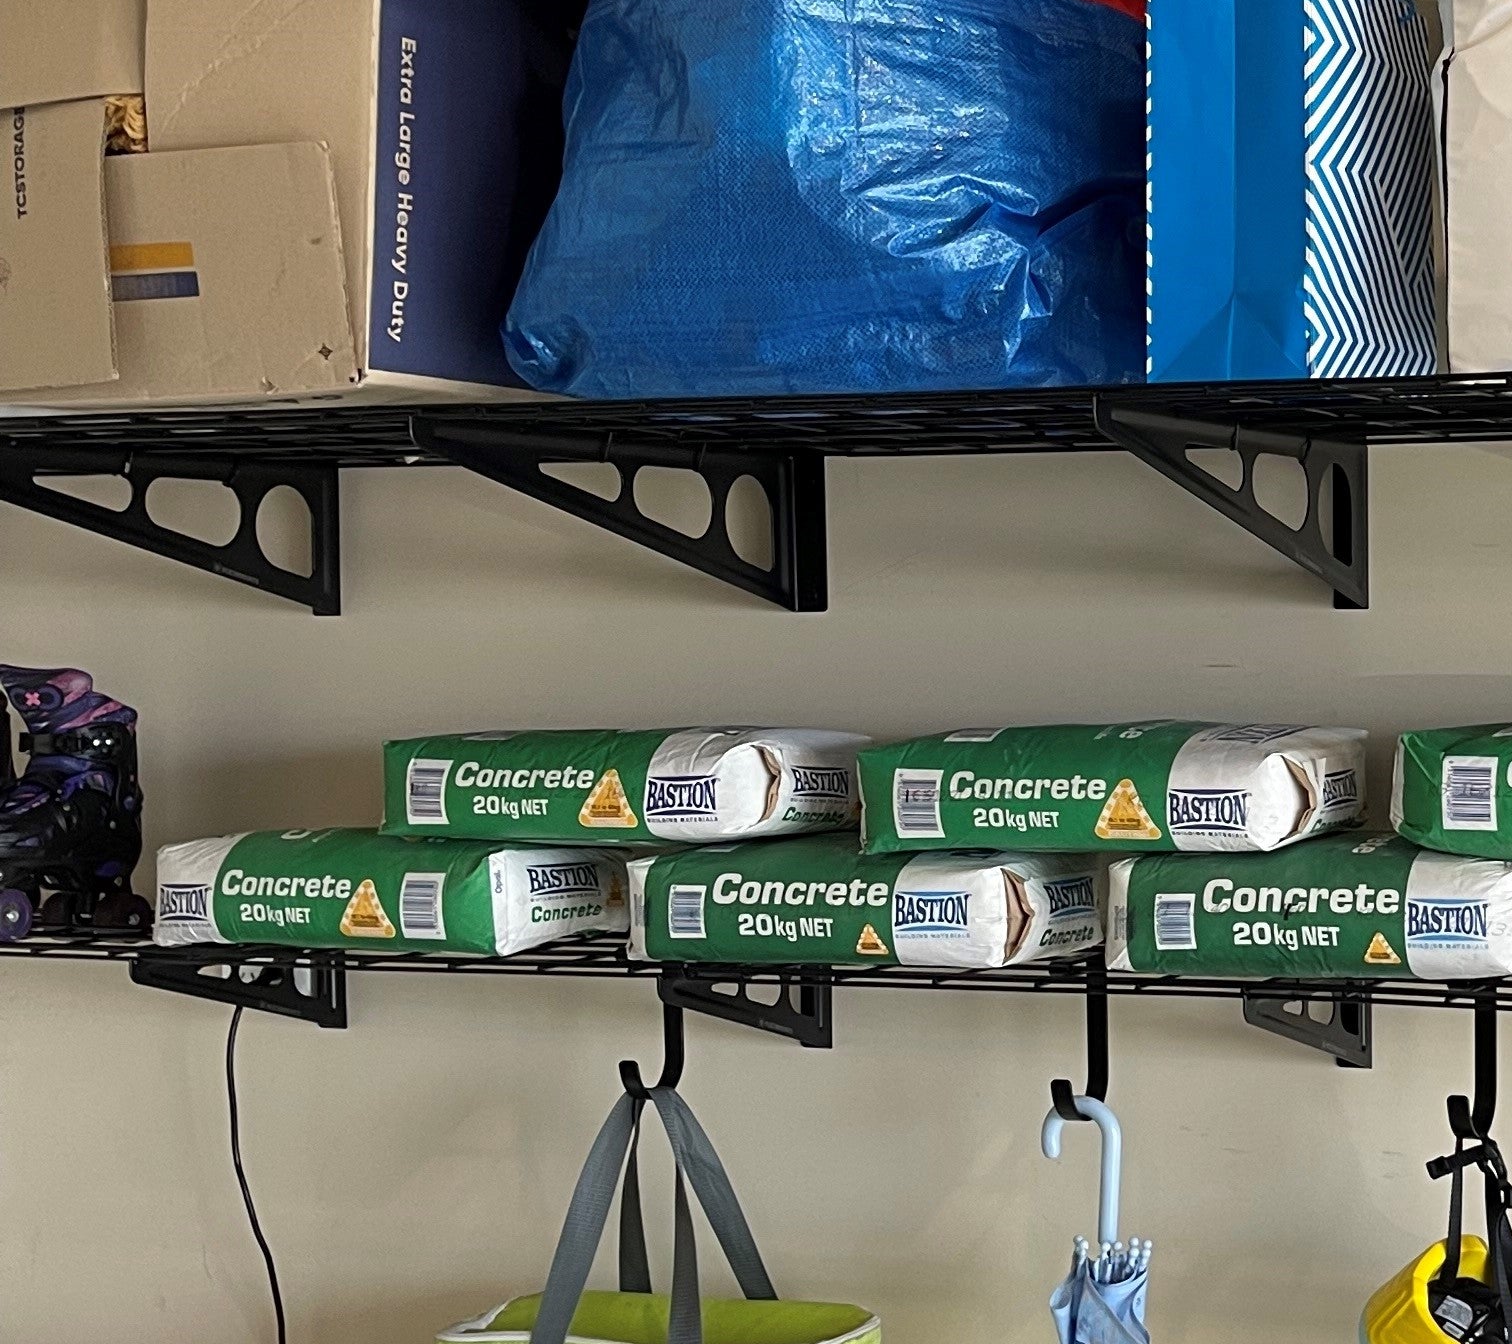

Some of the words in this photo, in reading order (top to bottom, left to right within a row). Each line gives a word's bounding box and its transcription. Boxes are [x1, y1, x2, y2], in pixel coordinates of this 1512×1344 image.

[400, 37, 417, 104] Extra
[395, 111, 415, 185] Large
[391, 193, 413, 274] Heavy
[387, 281, 409, 343] Duty
[454, 761, 595, 789] Concrete
[791, 767, 850, 796] BASTION
[949, 770, 1107, 801] Concrete
[472, 795, 520, 820] 20kg
[520, 798, 549, 816] NET
[645, 777, 718, 813] BASTION
[1168, 791, 1250, 827] BASTION
[972, 807, 1027, 832] 20kg
[1029, 810, 1060, 828] NET
[221, 869, 352, 899] Concrete
[526, 863, 600, 894] BASTION
[712, 872, 889, 907] Concrete
[1043, 877, 1094, 912] BASTION
[159, 885, 210, 919] BASTION
[894, 893, 969, 927] BASTION
[1202, 878, 1400, 914] Concrete
[239, 903, 285, 927] 20kg
[285, 907, 311, 924] NET
[531, 903, 603, 924] Concrete
[737, 913, 797, 942] 20kg
[799, 917, 834, 938] NET
[1407, 902, 1488, 938] BASTION
[1232, 921, 1299, 951] 20kg
[1301, 926, 1340, 946] NET
